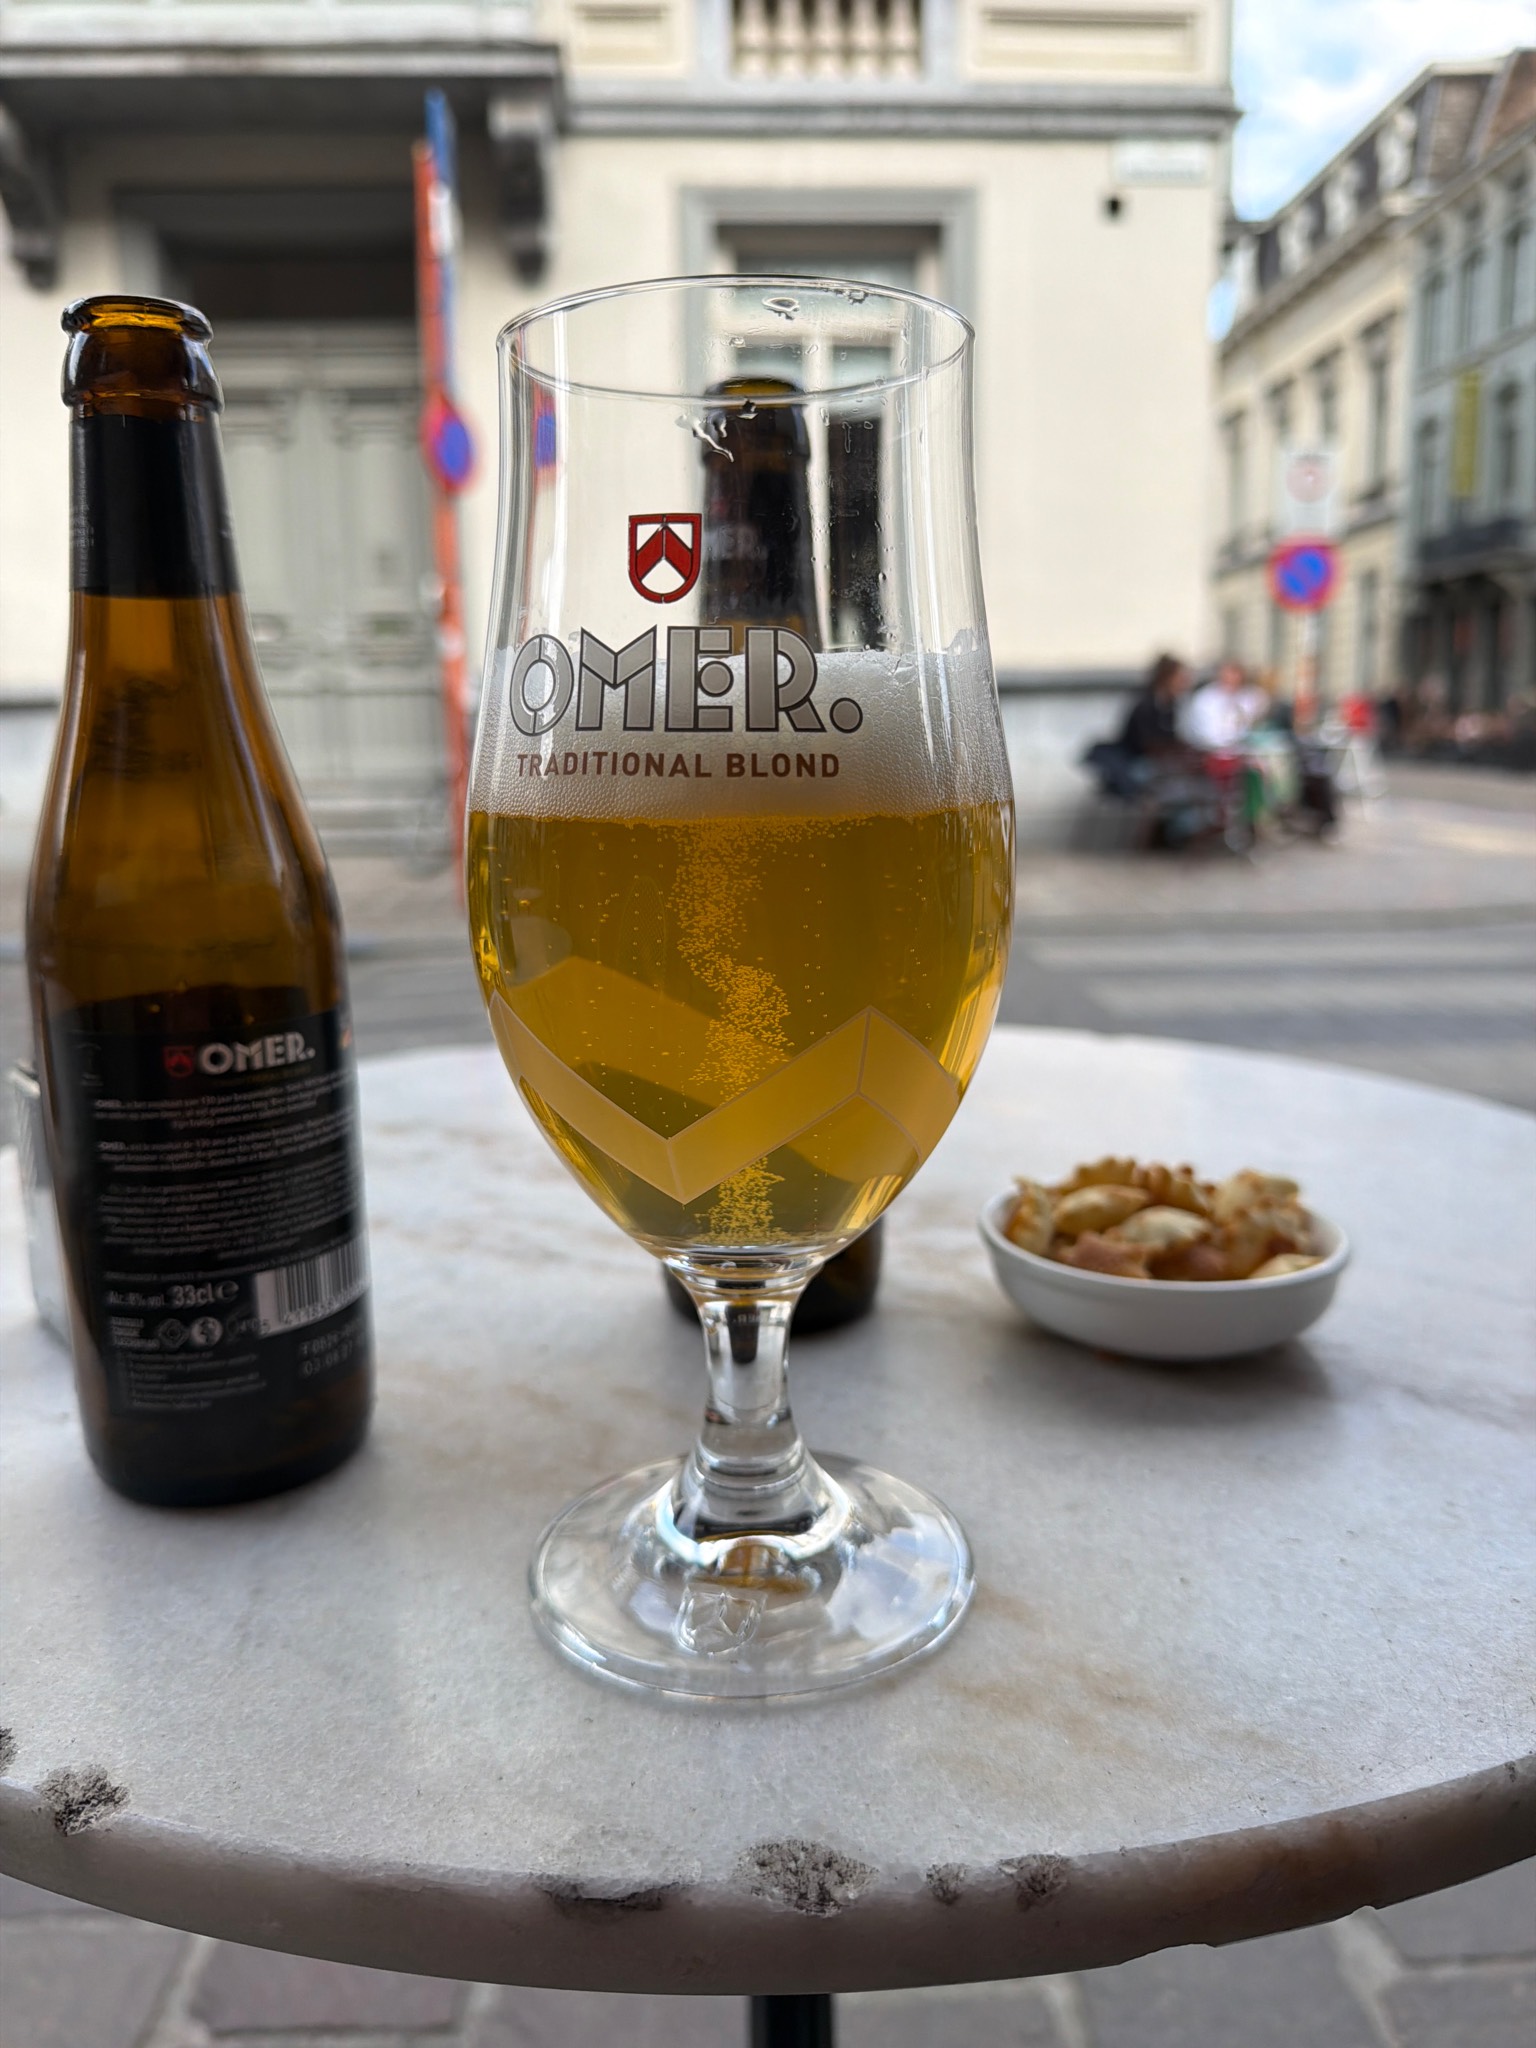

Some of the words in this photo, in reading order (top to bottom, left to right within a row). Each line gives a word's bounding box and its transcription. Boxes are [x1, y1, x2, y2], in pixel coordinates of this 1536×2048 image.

[509, 623, 864, 737] OMER.
[516, 750, 712, 778] TRADITIONAL
[726, 753, 840, 778] BLOND
[200, 1031, 316, 1075] OMER.
